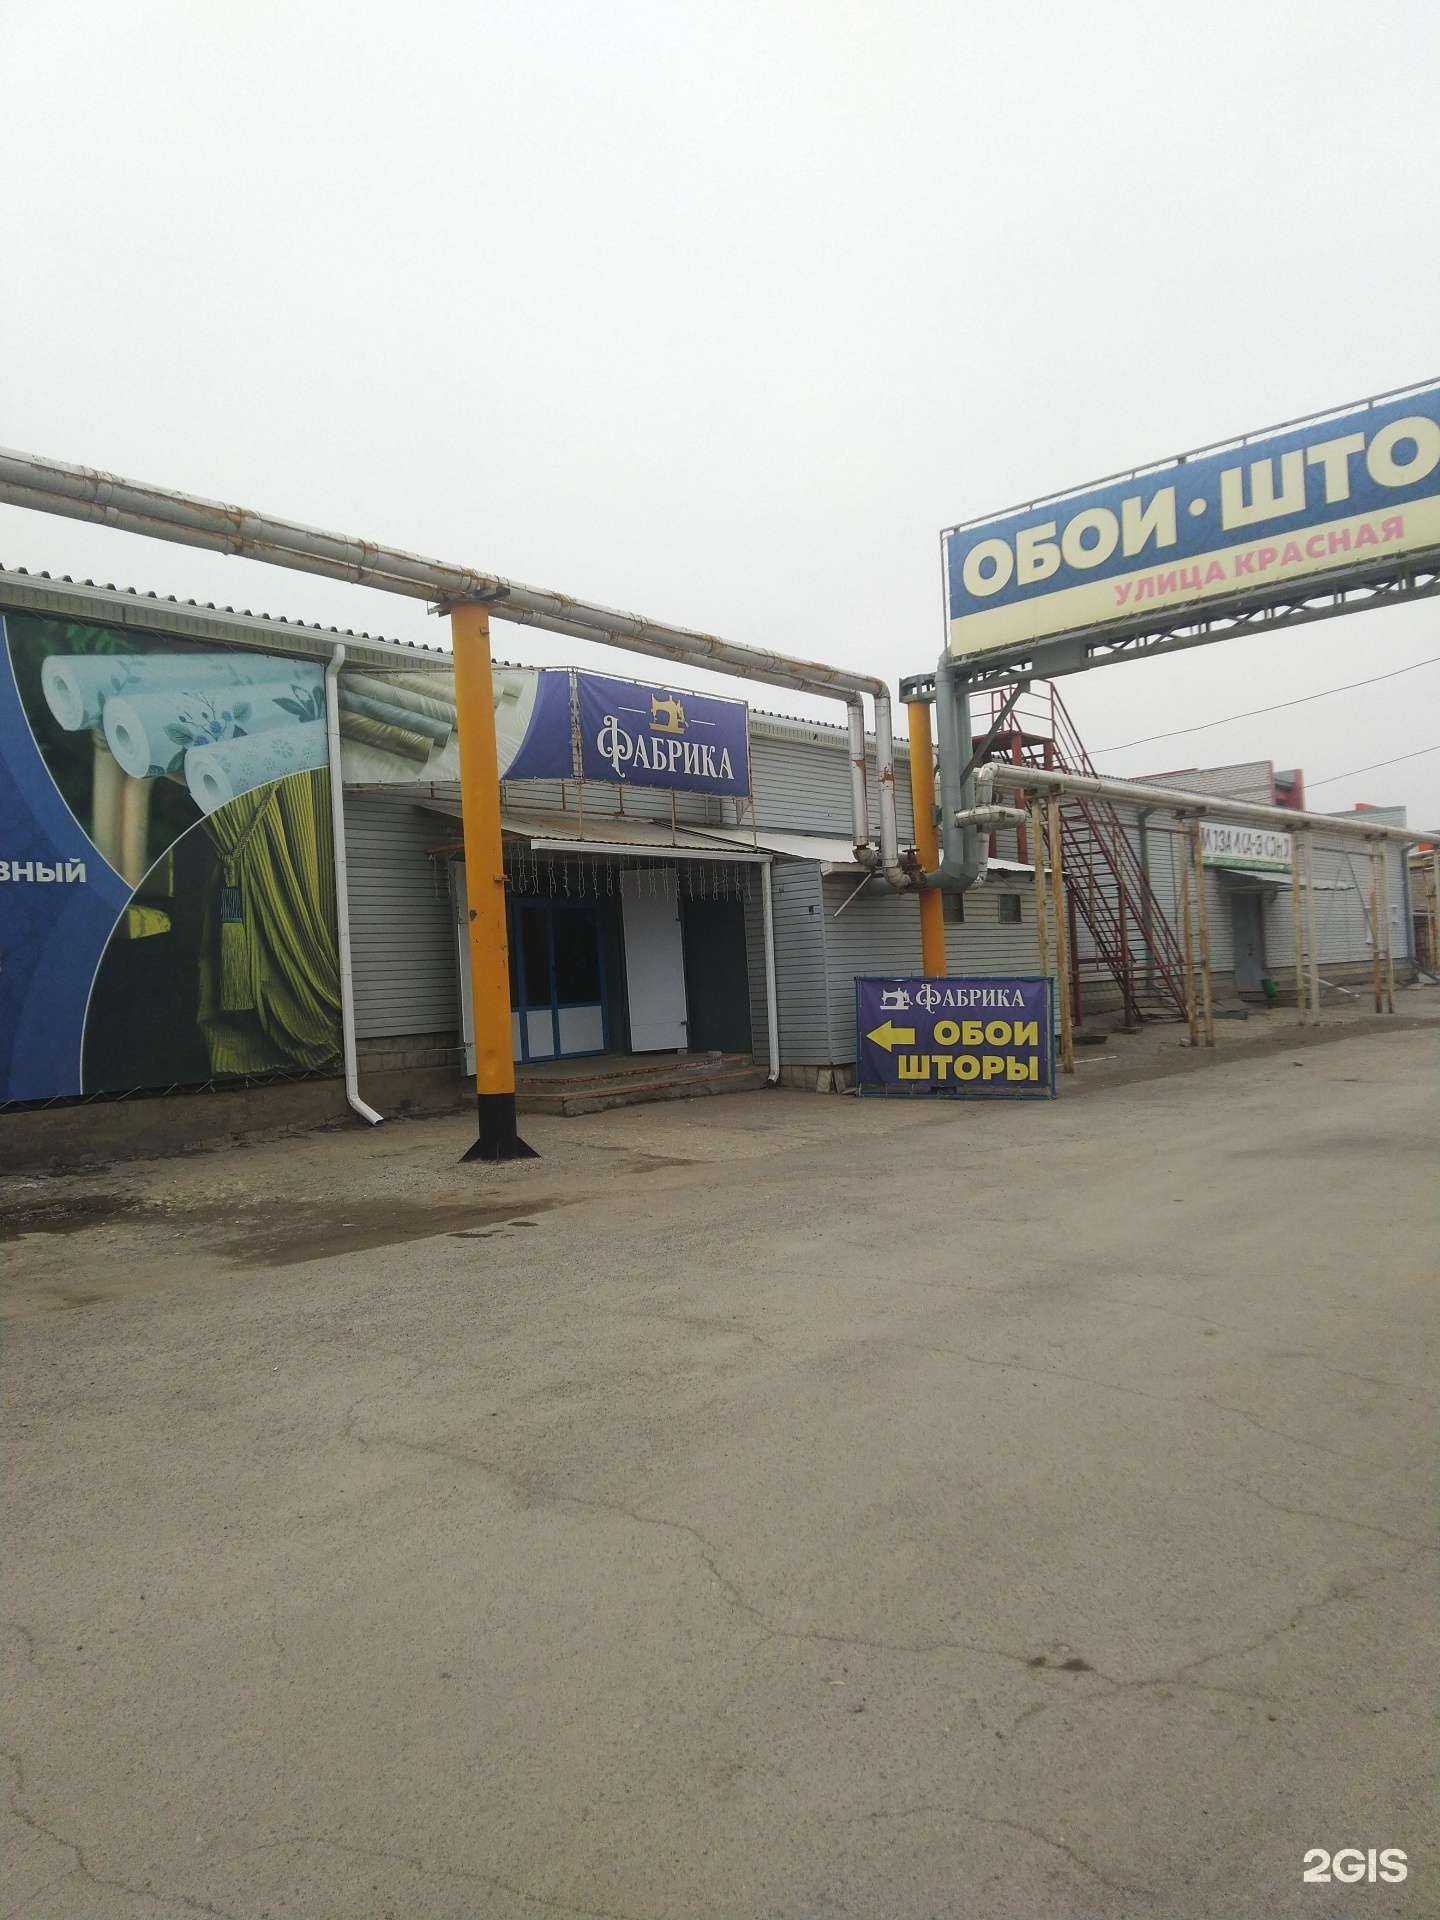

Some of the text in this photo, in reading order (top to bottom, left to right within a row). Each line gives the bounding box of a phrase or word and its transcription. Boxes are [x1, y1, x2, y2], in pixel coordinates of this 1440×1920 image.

[963, 416, 1440, 597] ОБОИ ШТО
[1114, 515, 1405, 606] УЛИЦА КРАСНАЯ
[933, 1020, 1038, 1046] ОБОИ
[898, 1054, 1039, 1081] ШТОРЫ
